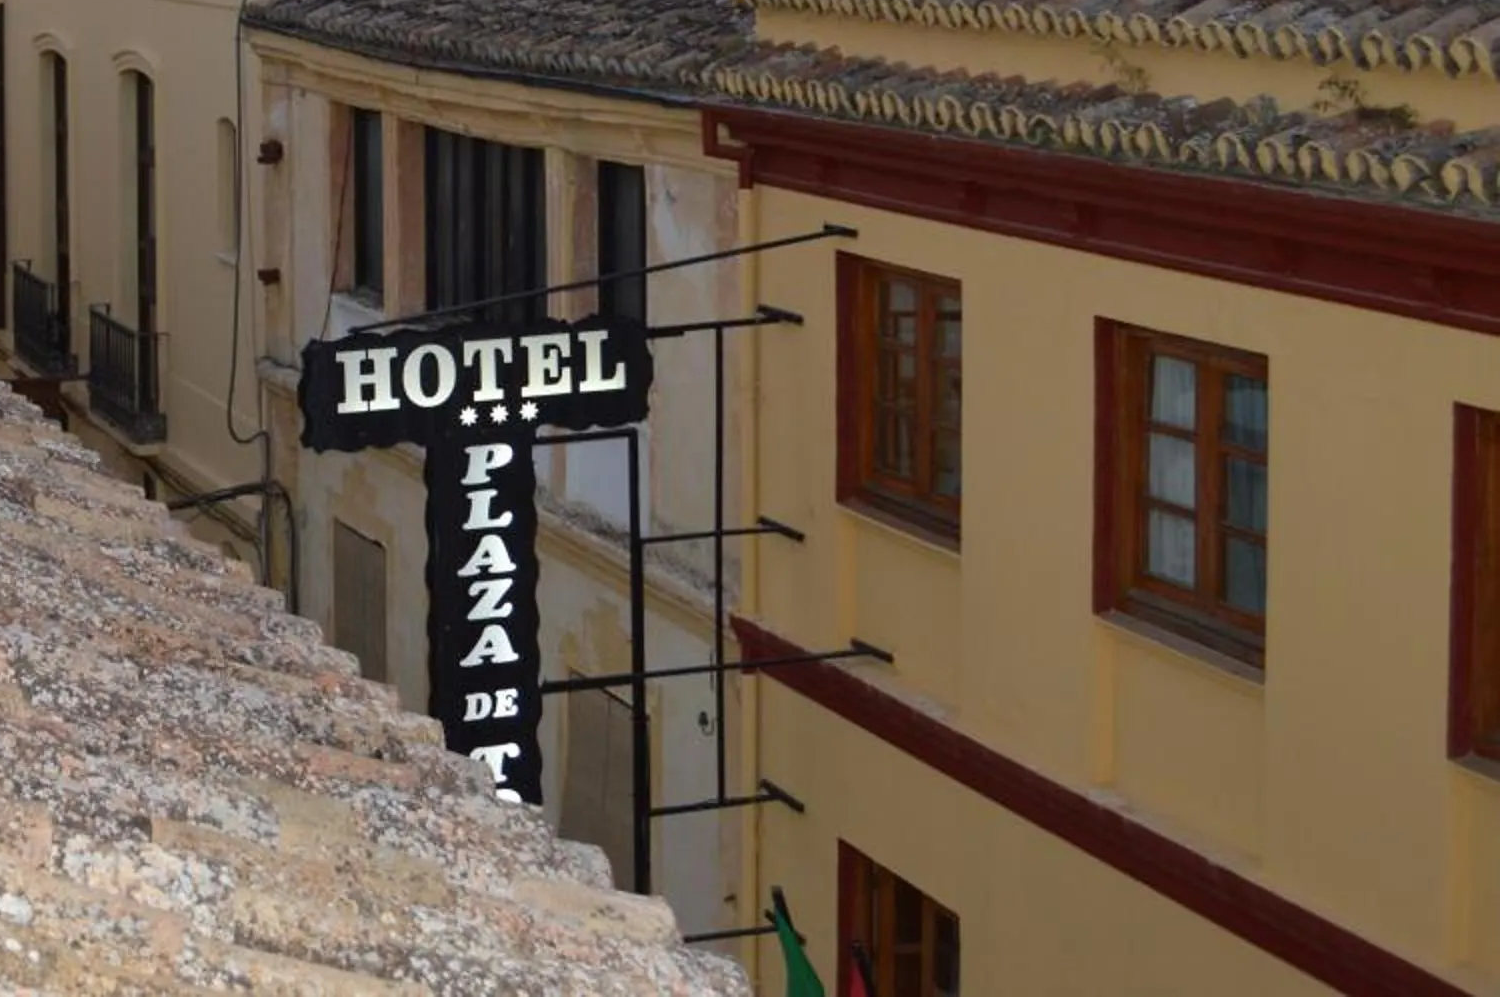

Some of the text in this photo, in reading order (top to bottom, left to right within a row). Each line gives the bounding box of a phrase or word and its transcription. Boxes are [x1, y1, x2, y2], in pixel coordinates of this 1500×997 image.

[336, 330, 626, 414] HOTEL
[457, 443, 519, 667] PLAZA
[463, 688, 520, 722] DE
